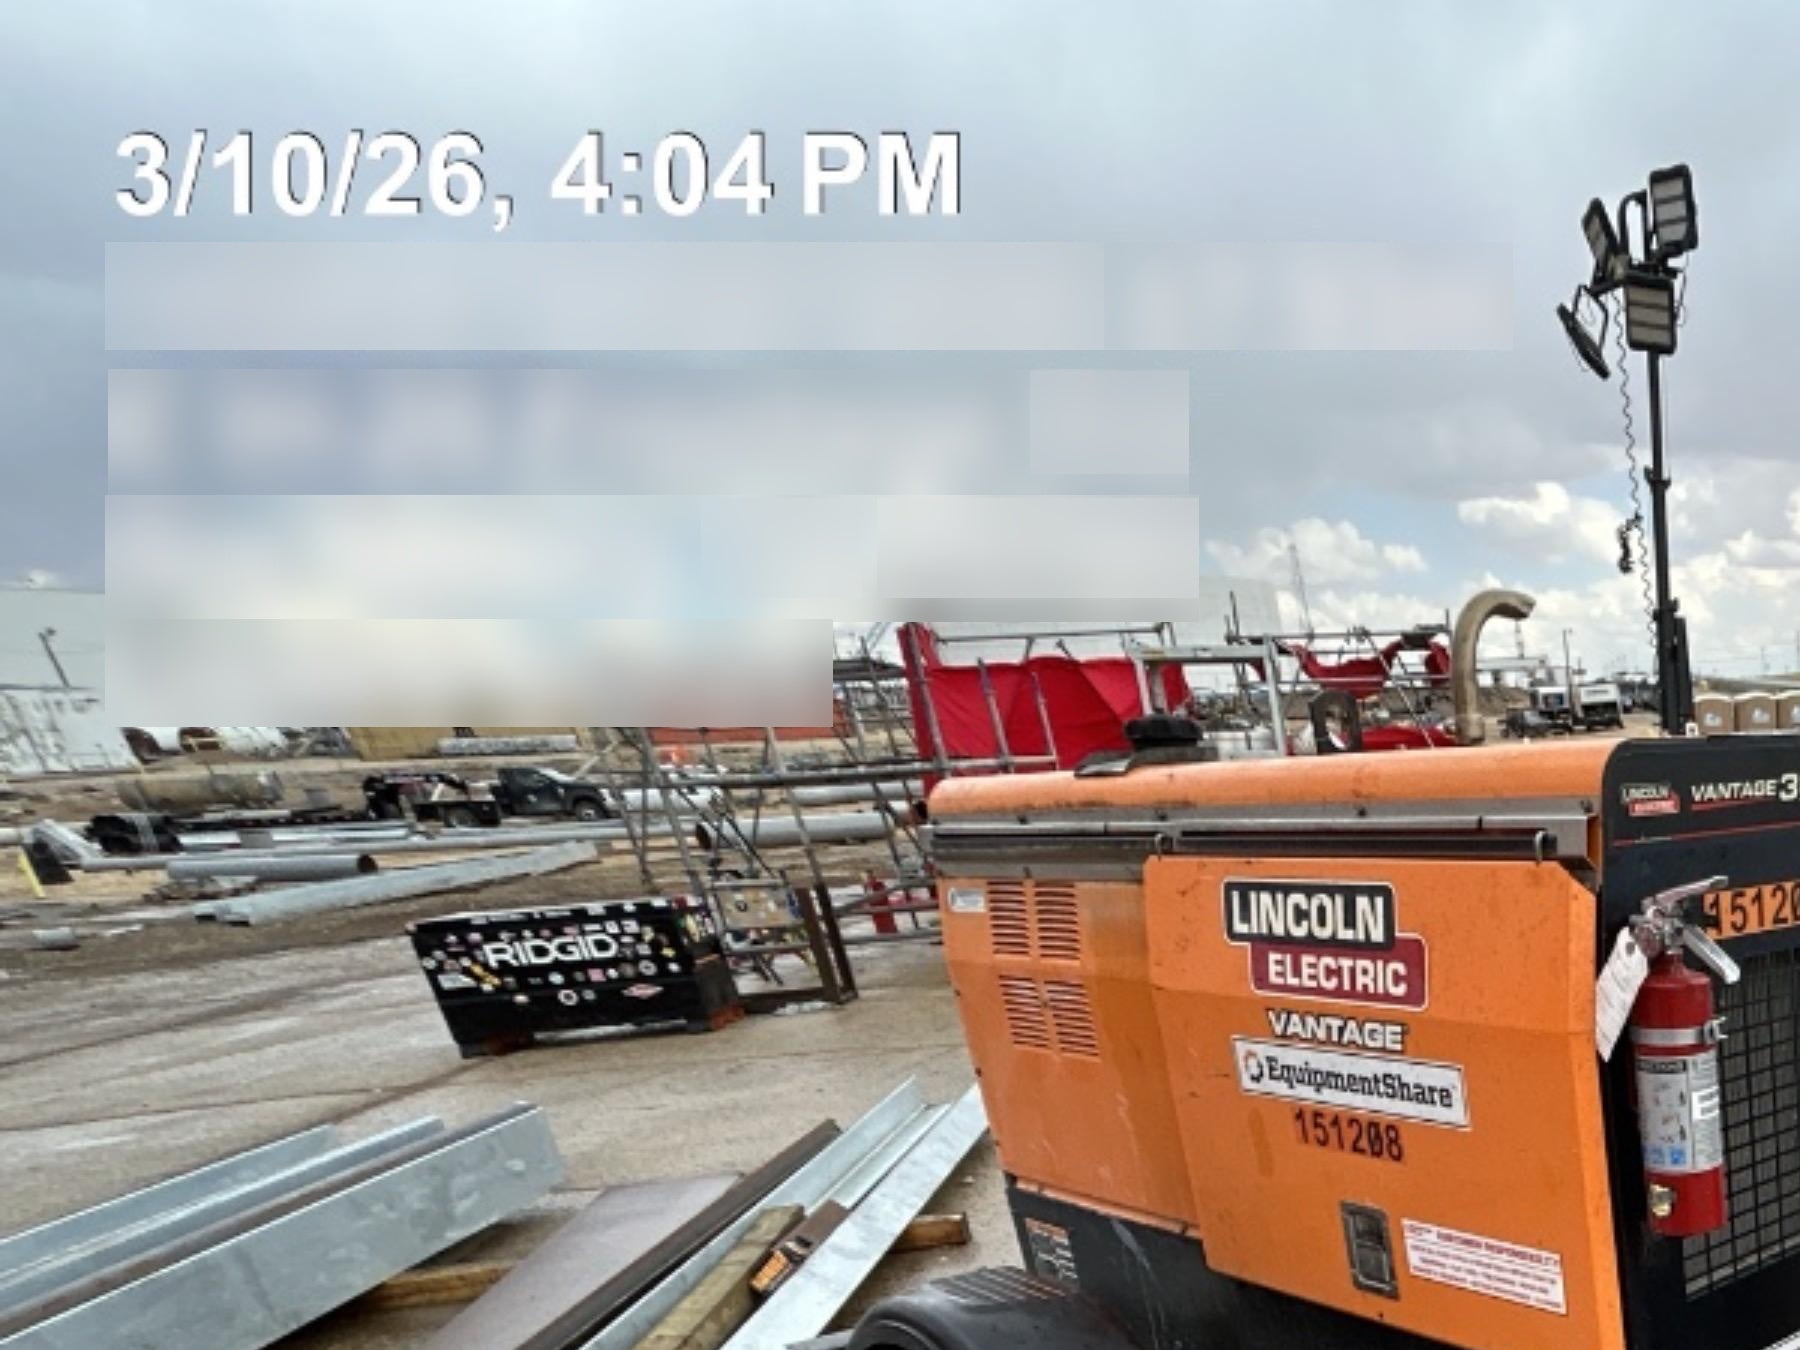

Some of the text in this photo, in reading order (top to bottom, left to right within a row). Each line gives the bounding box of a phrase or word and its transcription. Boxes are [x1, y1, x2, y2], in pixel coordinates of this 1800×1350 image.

[1691, 779, 1778, 802] VANTAGE
[1230, 889, 1386, 944] LINCOLN
[483, 933, 619, 968] RIDGID
[1267, 951, 1409, 998] ELECTRIC
[1266, 1007, 1408, 1052] VANTAGE
[1264, 1055, 1454, 1108] EquipmentShare
[1294, 1108, 1404, 1162] 151208
